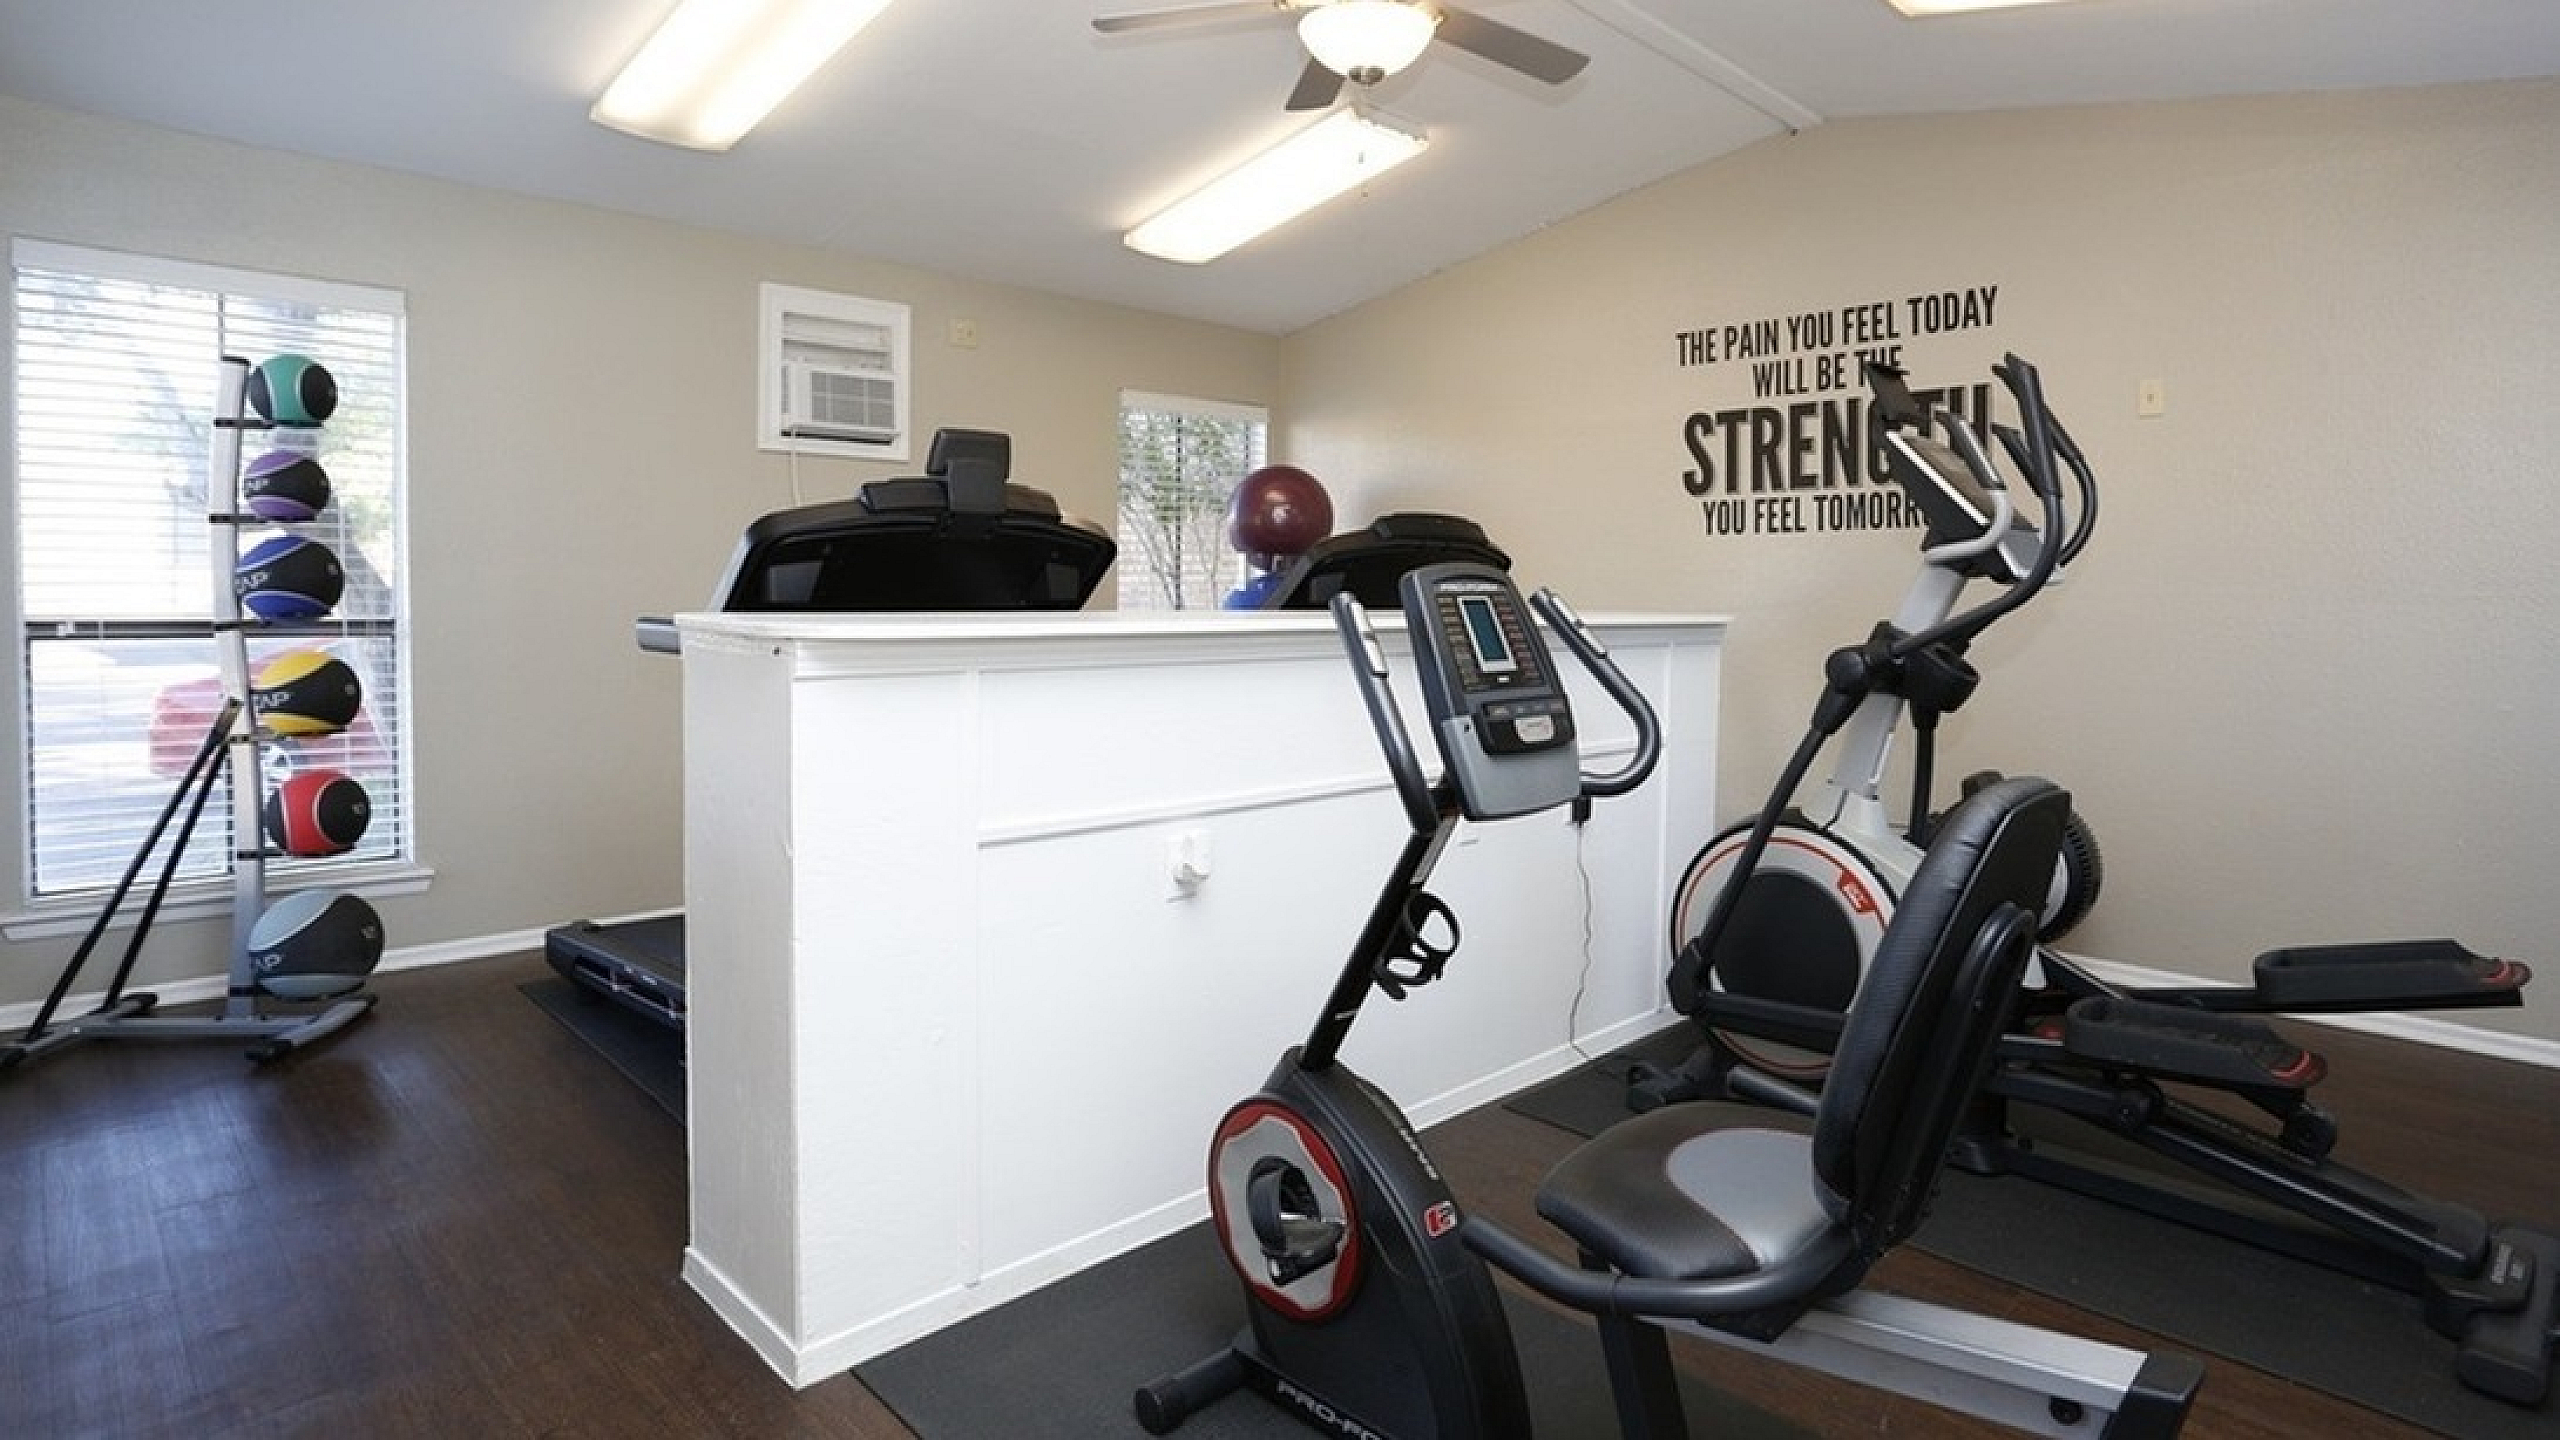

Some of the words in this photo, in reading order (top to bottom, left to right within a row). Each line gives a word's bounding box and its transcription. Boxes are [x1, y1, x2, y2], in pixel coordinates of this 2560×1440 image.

[1676, 329, 1717, 366] THE
[1724, 319, 1779, 361] PAIN
[1787, 311, 1834, 353] YOU
[1842, 301, 1900, 345] FEEL
[1908, 284, 1998, 335] TODAY
[1753, 358, 1809, 398] WILL
[1816, 352, 1847, 391] BE
[1703, 500, 1745, 535] YOU
[1754, 496, 1807, 533] FEEL
